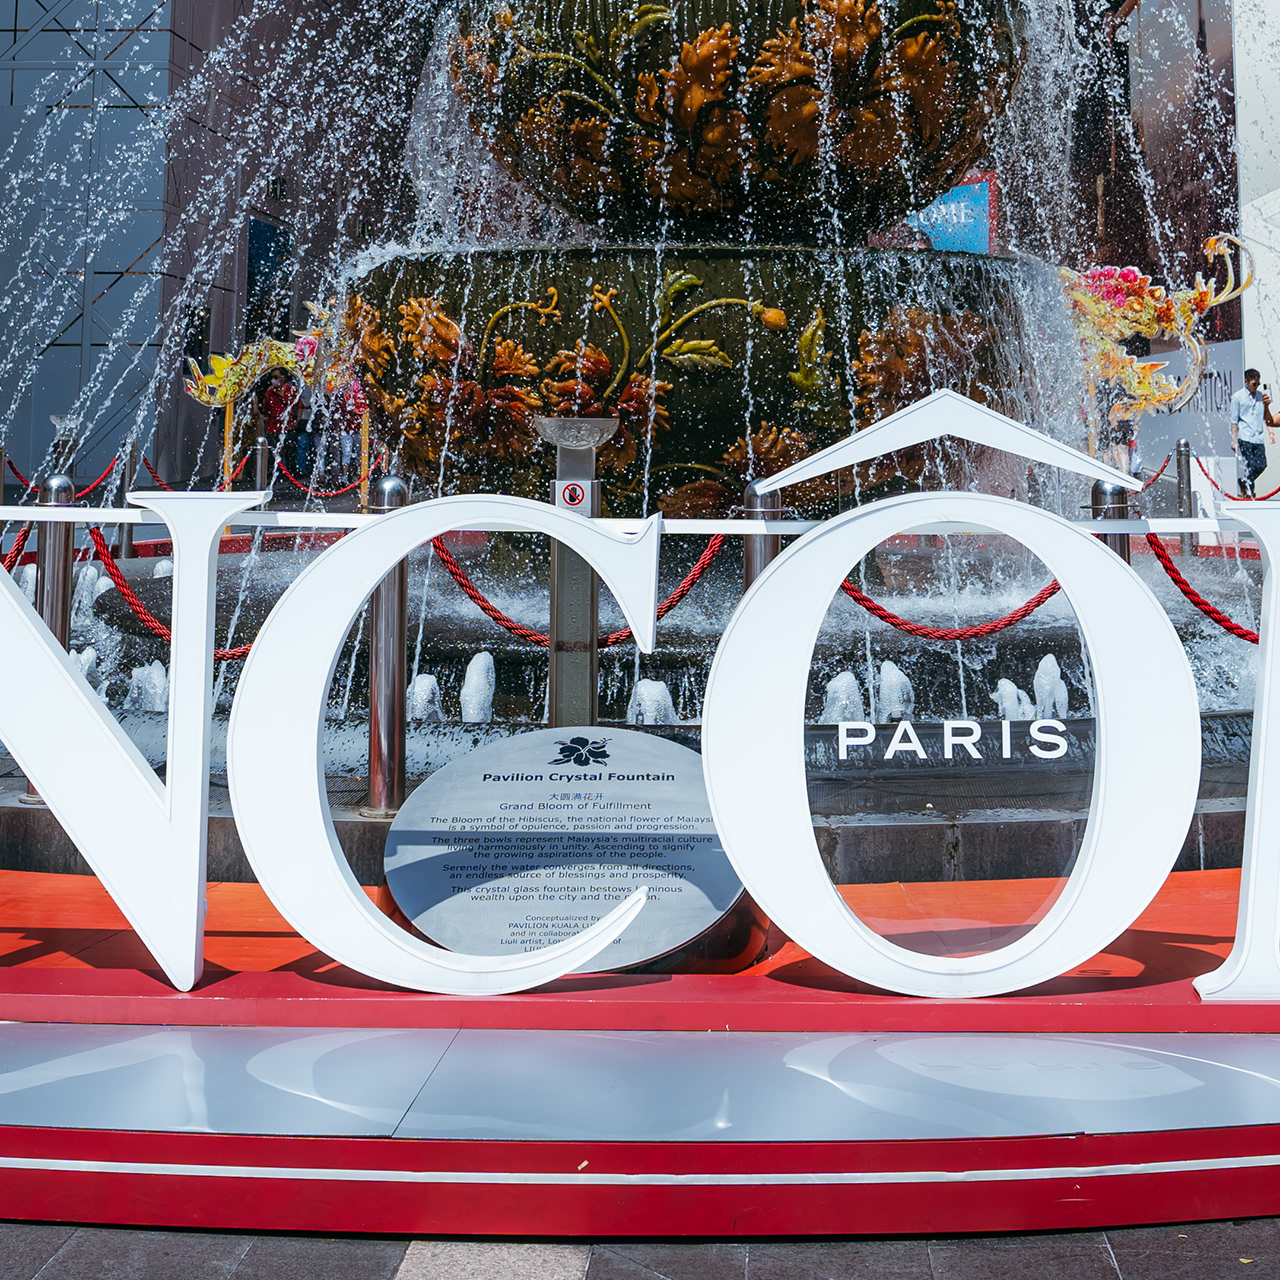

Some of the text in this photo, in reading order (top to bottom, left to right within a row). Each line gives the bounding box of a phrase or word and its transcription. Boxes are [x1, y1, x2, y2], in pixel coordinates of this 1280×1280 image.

[837, 718, 1069, 760] PARIS
[482, 772, 675, 784] Pavilion Crystal Fountain
[499, 802, 652, 810] Grand Bloom of Fulfillment
[430, 816, 449, 824] The
[451, 816, 483, 824] Bloom
[485, 816, 497, 824] of
[518, 816, 563, 825] Hibiscus,
[629, 815, 661, 823] flower
[663, 815, 675, 823] of
[676, 815, 714, 824] Malaysi
[448, 824, 459, 832] is
[459, 824, 466, 832] a
[469, 823, 506, 833] symbol
[508, 823, 519, 831] of
[521, 823, 570, 832] opulence,
[573, 823, 611, 832] passion
[636, 823, 698, 832] progression.
[431, 835, 713, 845] The three bowls represent Malaysia's multiracial culture
[477, 843, 547, 852] harmoniously
[549, 843, 559, 851] in
[561, 843, 590, 852] unity.
[593, 843, 646, 852] Ascending
[648, 843, 659, 851] to
[661, 843, 696, 852] signify
[473, 851, 491, 859] the
[493, 851, 534, 860] growing
[537, 851, 593, 859] aspirations
[629, 851, 667, 860] people.
[442, 864, 488, 872] Serenely
[542, 864, 596, 872] converges
[598, 863, 624, 871] from
[626, 863, 639, 871] all
[641, 863, 696, 872] directions,
[465, 871, 505, 879] endless
[544, 871, 556, 879] of
[558, 871, 606, 880] blessings
[608, 871, 629, 879] and
[631, 871, 687, 880] prosperity.
[450, 885, 683, 894] This crystal glass fountain bestows lminous
[470, 893, 505, 901] wealth
[508, 894, 535, 902] upon
[538, 893, 556, 901] the
[558, 893, 578, 902] city
[580, 893, 600, 901] and
[603, 893, 621, 901] the
[525, 914, 601, 923] Conceptualized by
